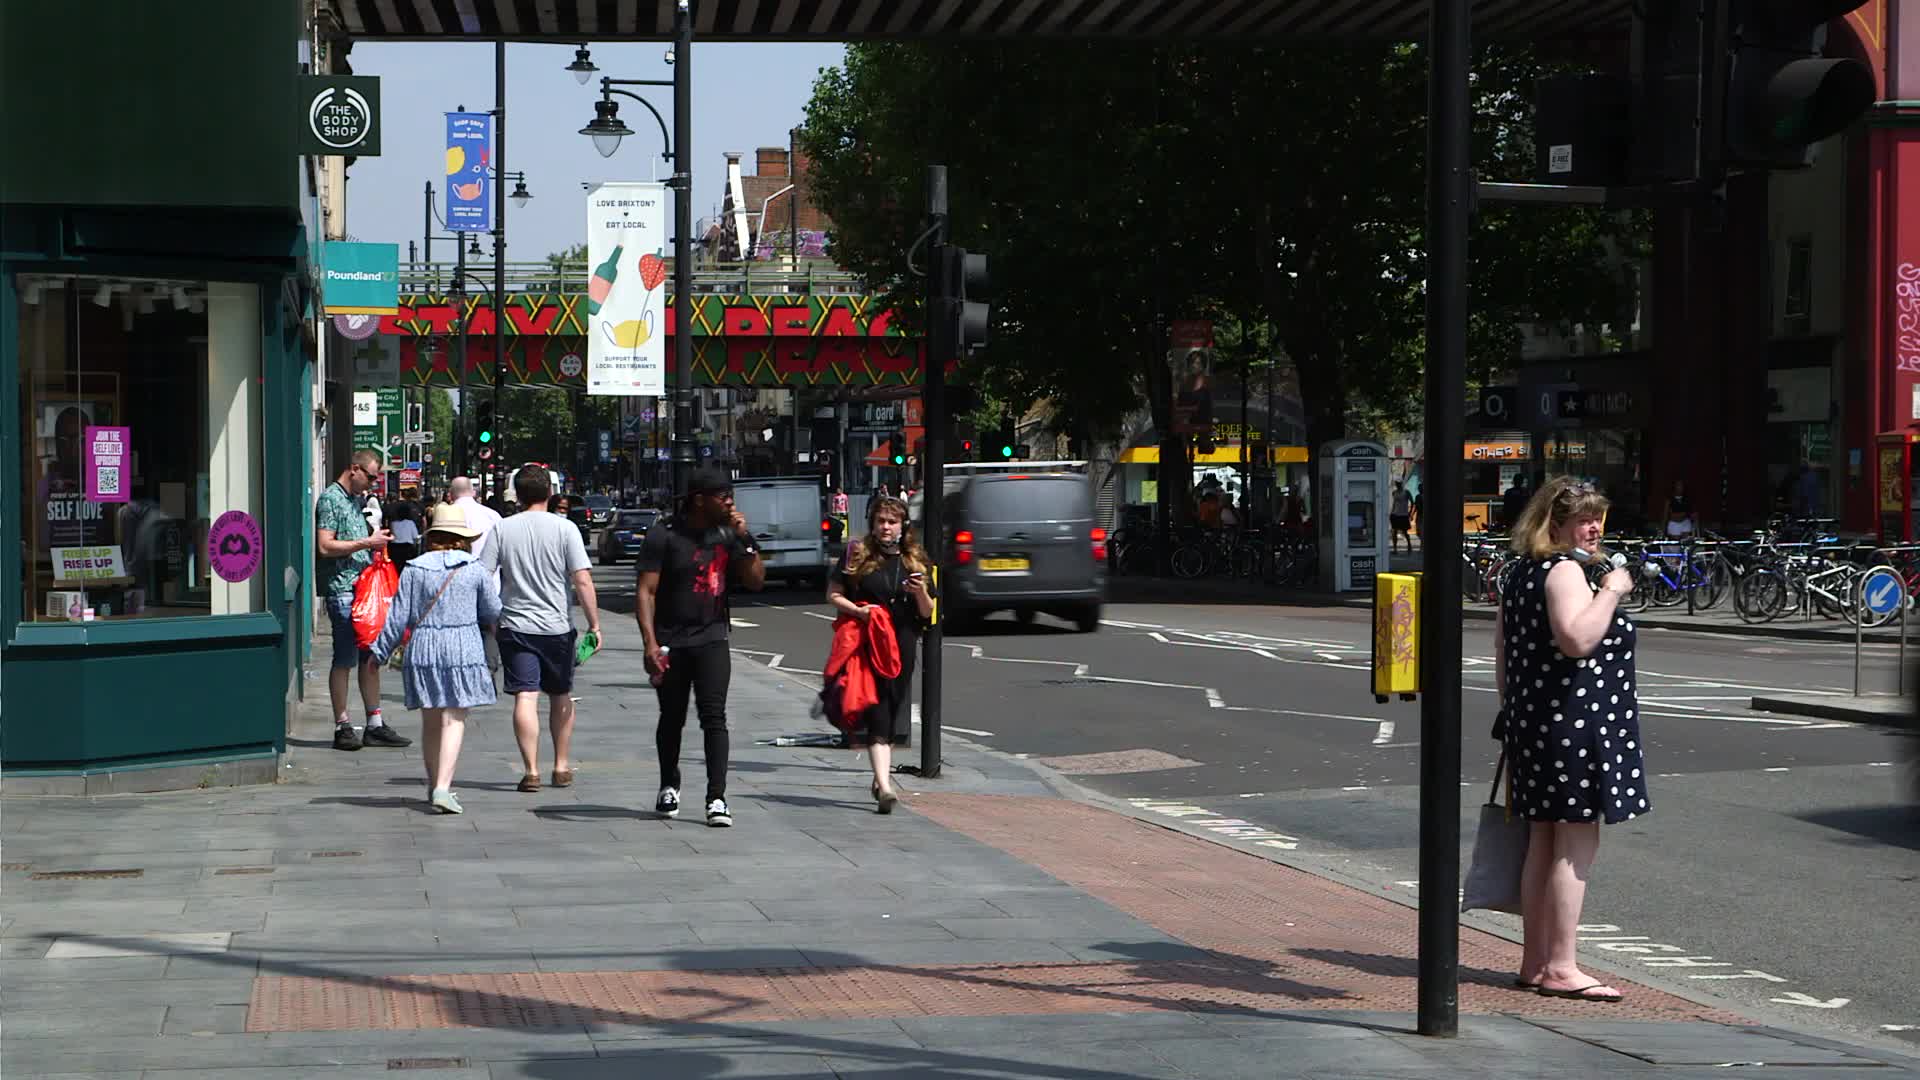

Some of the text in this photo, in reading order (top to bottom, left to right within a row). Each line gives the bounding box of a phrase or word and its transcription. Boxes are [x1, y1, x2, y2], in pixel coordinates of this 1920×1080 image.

[329, 106, 351, 115] THE
[322, 115, 359, 126] BODY
[324, 126, 358, 136] SHOP
[596, 199, 656, 207] LOVE BRIXTON?
[606, 221, 647, 229] EAT LOCAL
[327, 270, 381, 281] Poundland
[1351, 447, 1372, 455] cash
[1472, 445, 1512, 457] OTHER
[46, 501, 104, 520] SELF LOVE
[62, 547, 112, 559] RISE UP
[63, 558, 113, 569] RISE UP
[1351, 558, 1375, 568] cash
